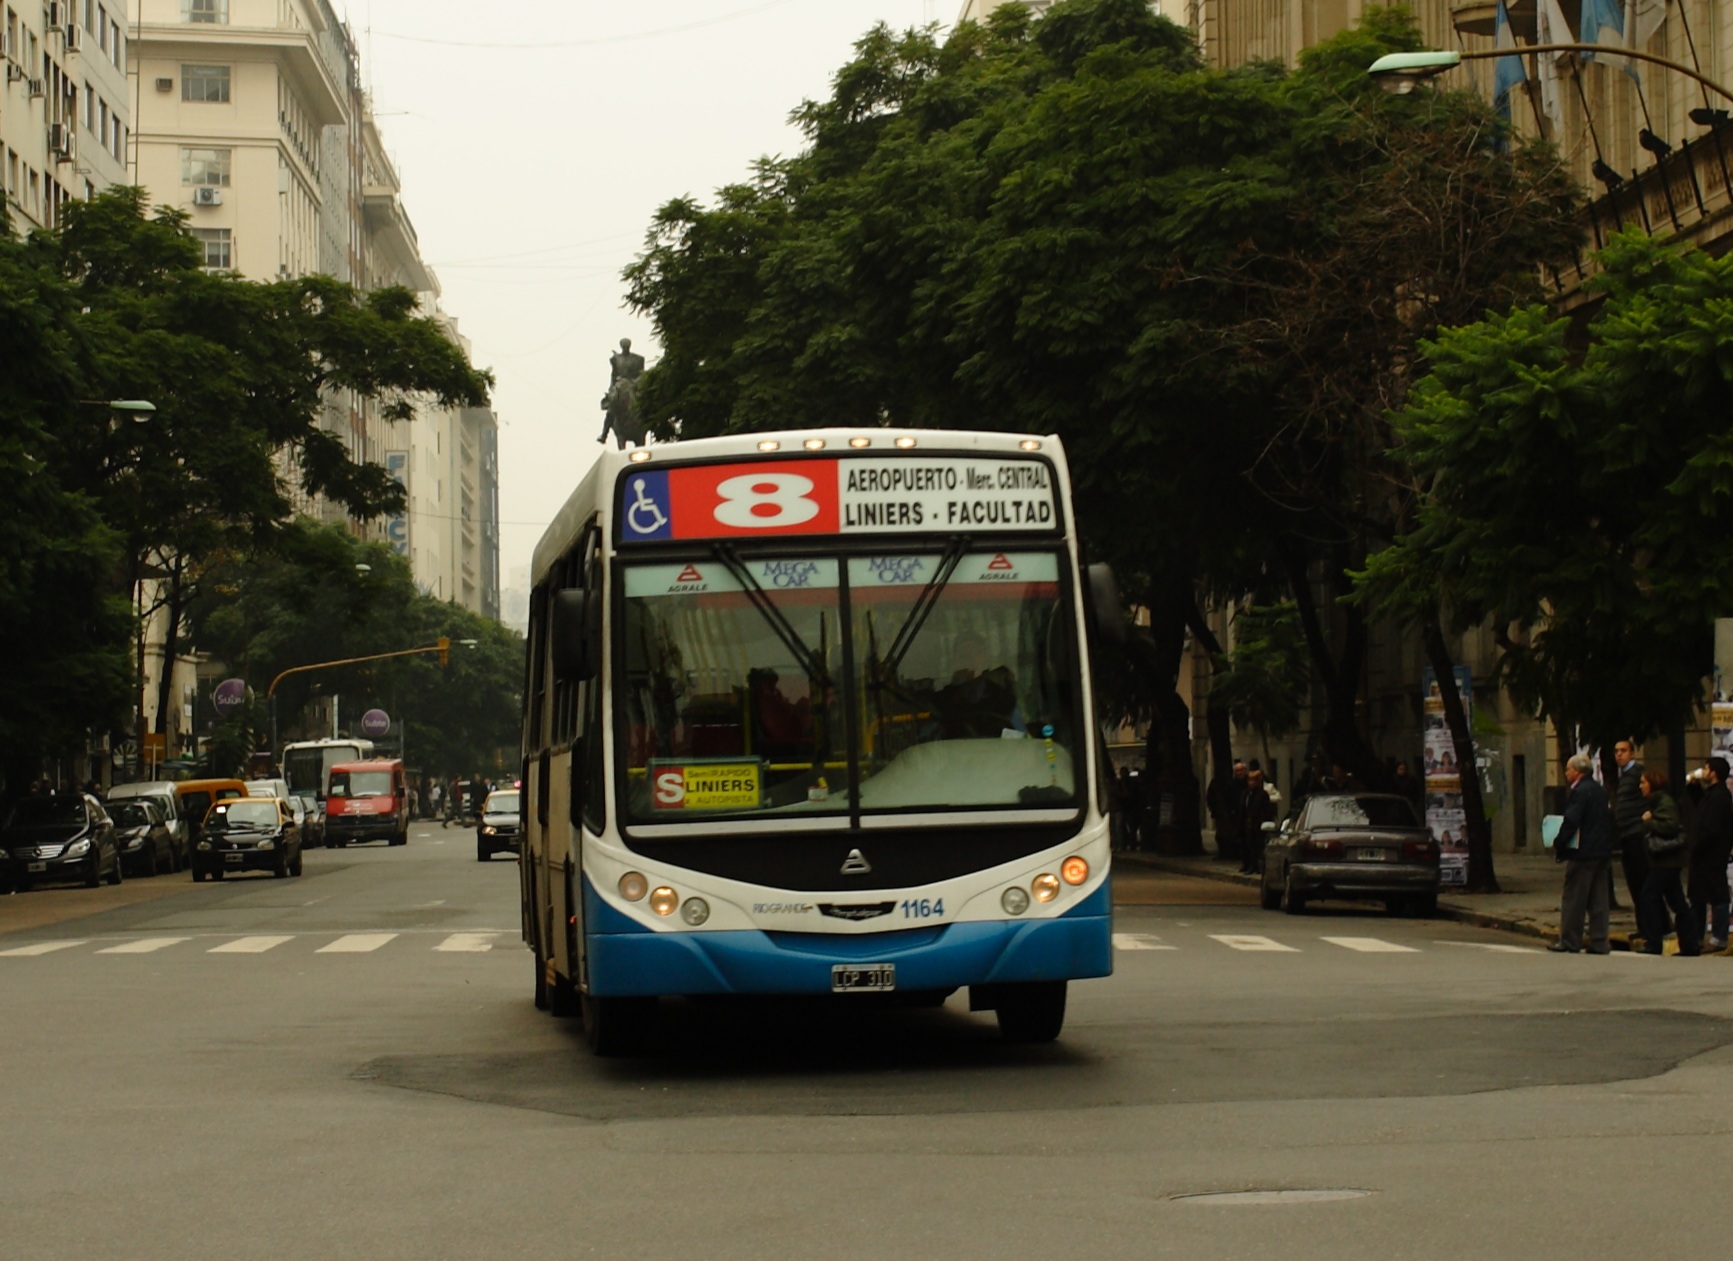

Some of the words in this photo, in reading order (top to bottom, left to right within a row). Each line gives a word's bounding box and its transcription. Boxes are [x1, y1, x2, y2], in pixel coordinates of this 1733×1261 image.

[847, 467, 956, 492] AEROPUERTO
[966, 467, 995, 490] Merc.
[997, 465, 1049, 491] CENTRAL
[713, 472, 820, 528] 8
[845, 502, 924, 526] LINIERS
[948, 500, 1051, 525] FACULTAD
[763, 560, 820, 577] MEGA
[868, 556, 924, 572] MEGA
[772, 573, 813, 588] CAR
[877, 568, 917, 583] CAR
[978, 572, 1019, 581] AGRALE
[667, 583, 709, 593] AGRALE
[656, 772, 685, 803] S
[686, 779, 755, 793] LINIERS
[901, 898, 945, 918] 1164
